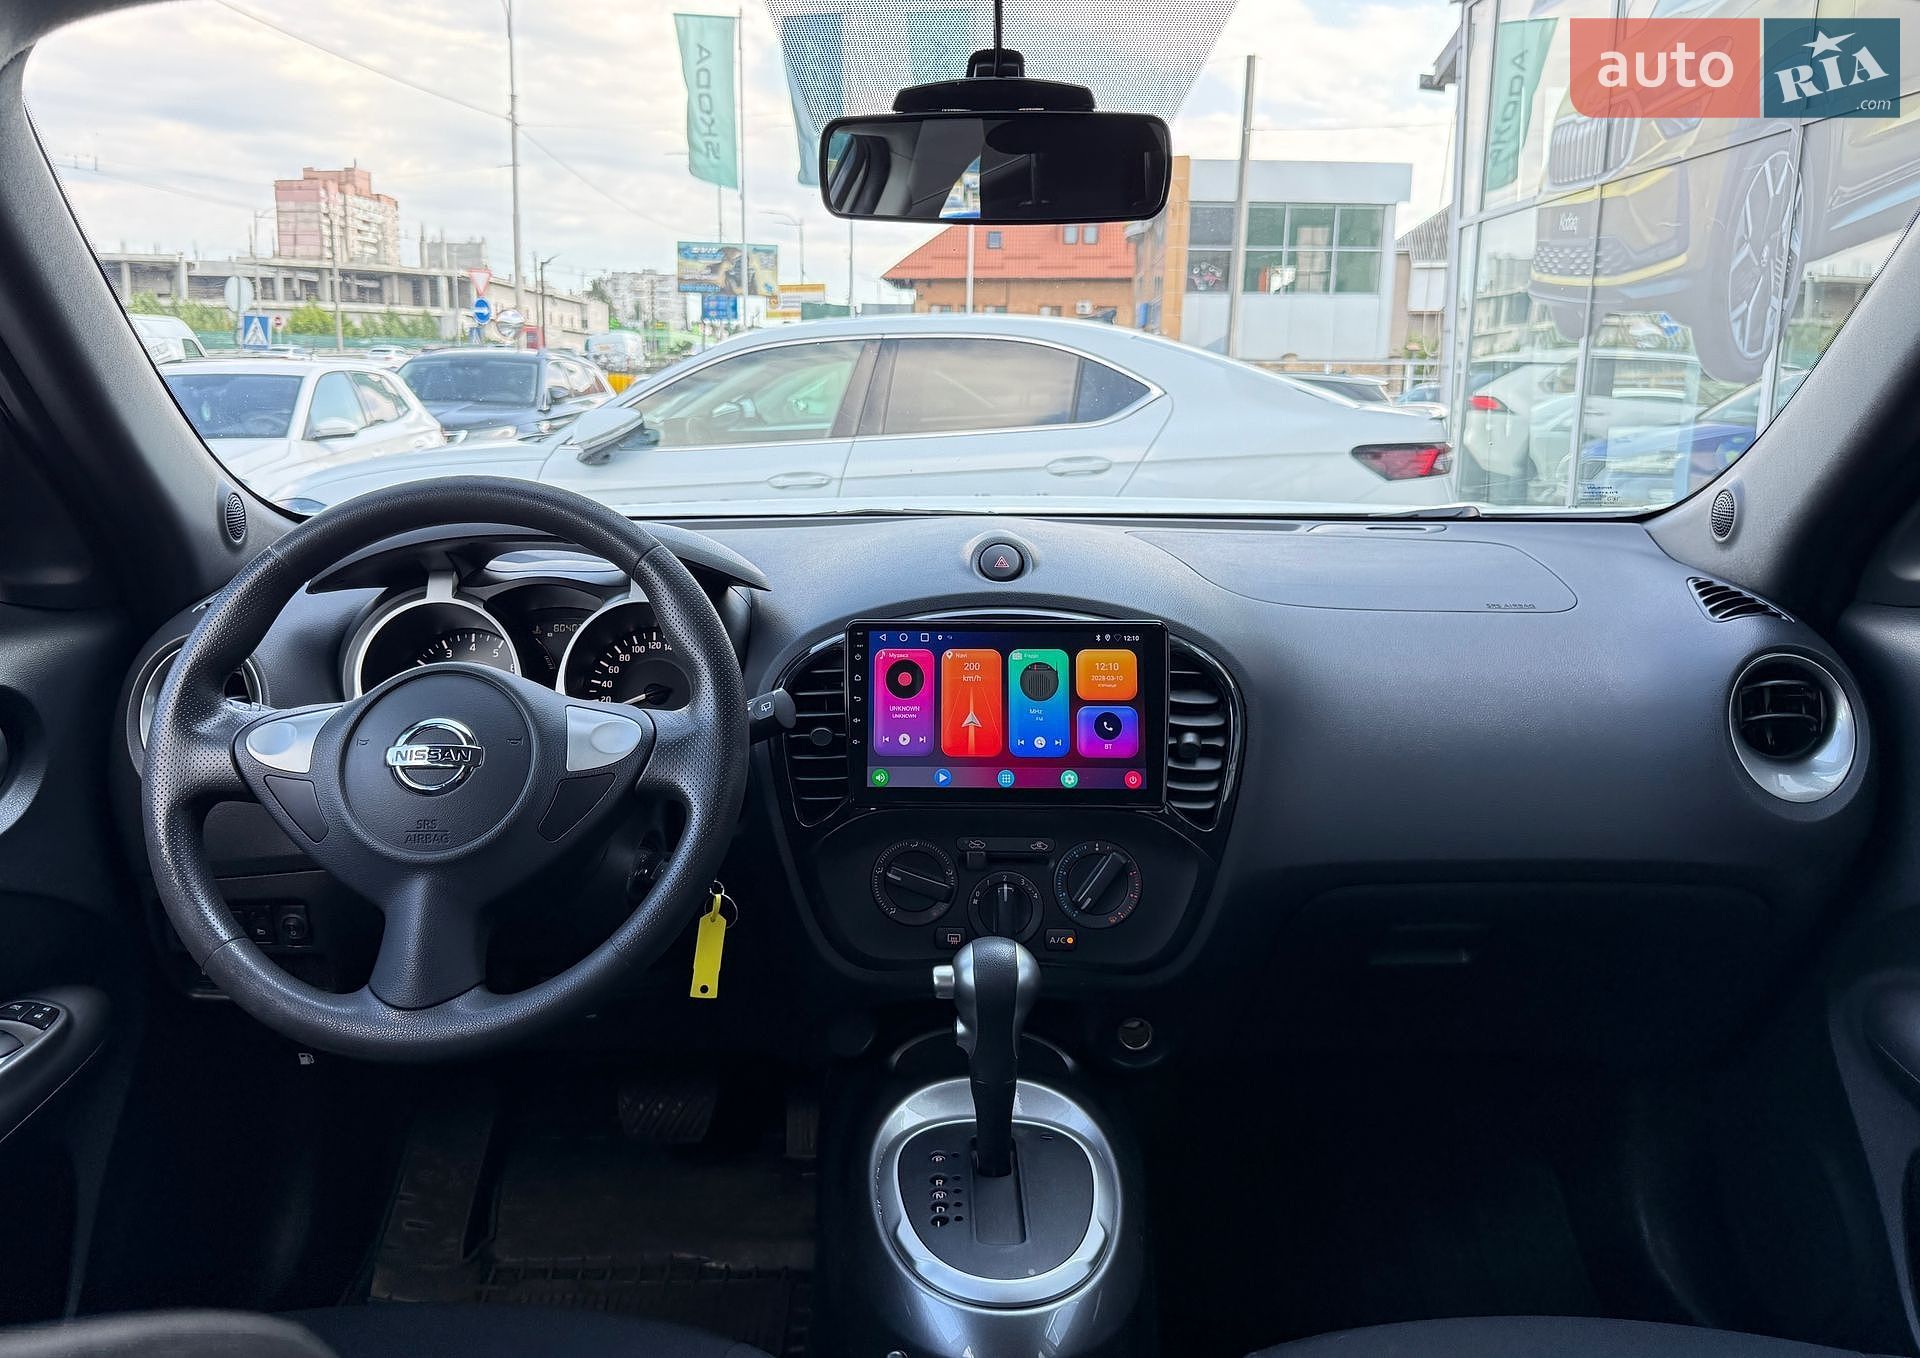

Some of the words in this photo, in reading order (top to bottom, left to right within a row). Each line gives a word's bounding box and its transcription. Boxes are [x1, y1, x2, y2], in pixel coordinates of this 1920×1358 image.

[553, 623, 581, 633] 8040
[469, 643, 476, 652] 4
[631, 645, 645, 653] 100
[648, 642, 661, 650] 120
[446, 649, 453, 658] 3
[492, 648, 499, 657] 5
[619, 654, 630, 662] 80
[608, 666, 620, 674] 60
[963, 662, 981, 671] 200
[1095, 662, 1119, 671] 12:10
[962, 674, 982, 682] km/h
[601, 680, 613, 688] 40
[394, 748, 471, 762] NISSAN
[416, 819, 437, 829] SRS
[404, 833, 450, 844] AIRBAG
[1049, 936, 1066, 944] A/C
